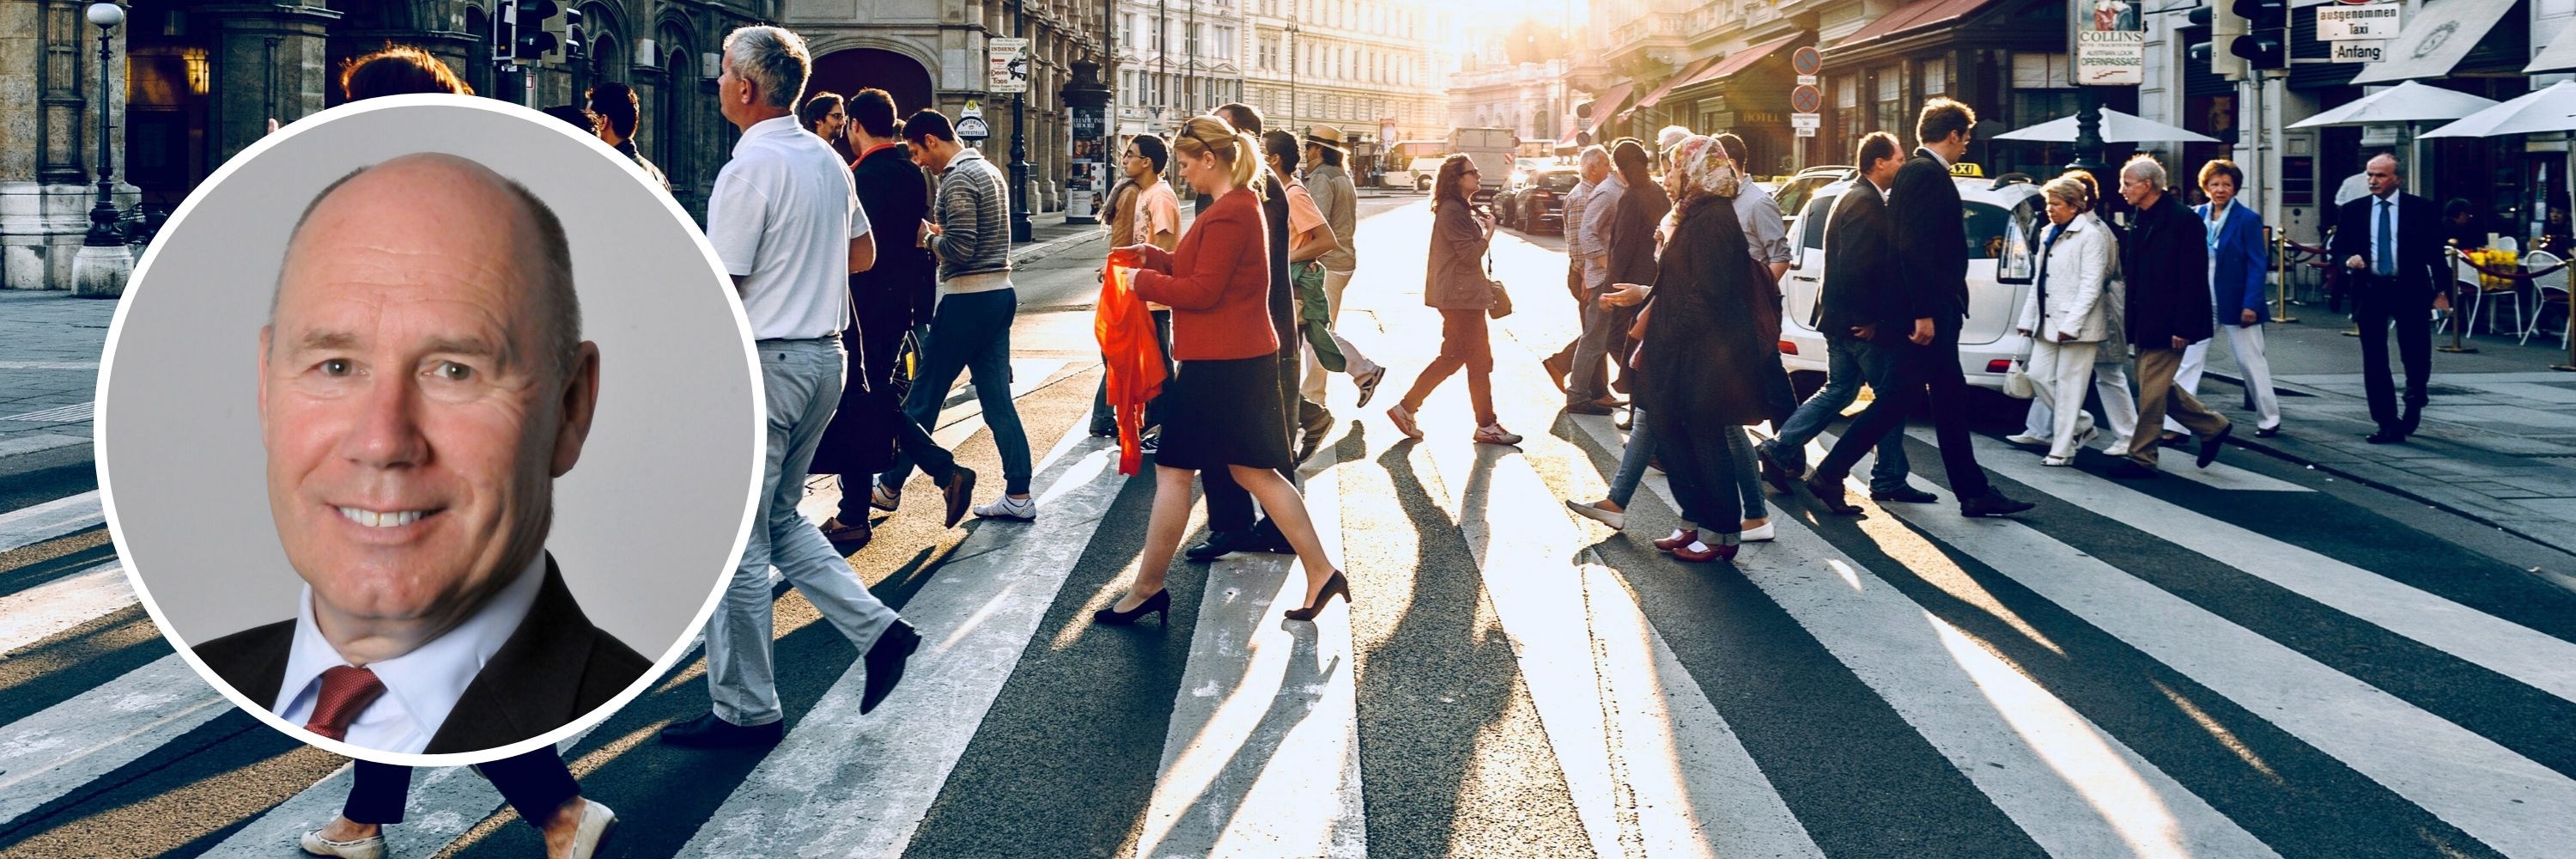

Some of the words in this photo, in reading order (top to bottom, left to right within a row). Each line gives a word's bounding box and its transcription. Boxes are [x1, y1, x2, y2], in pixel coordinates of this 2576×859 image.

[2320, 9, 2397, 21] ausgenommen
[2348, 22, 2368, 34] Taxi
[2080, 31, 2142, 42] COLLINS
[2337, 46, 2380, 60] Anfang
[2081, 58, 2141, 66] OPERNPASSAGE
[1743, 112, 1780, 122] HOTEL
[962, 119, 982, 128] AUTOBUS
[1950, 164, 1973, 174] AXI
